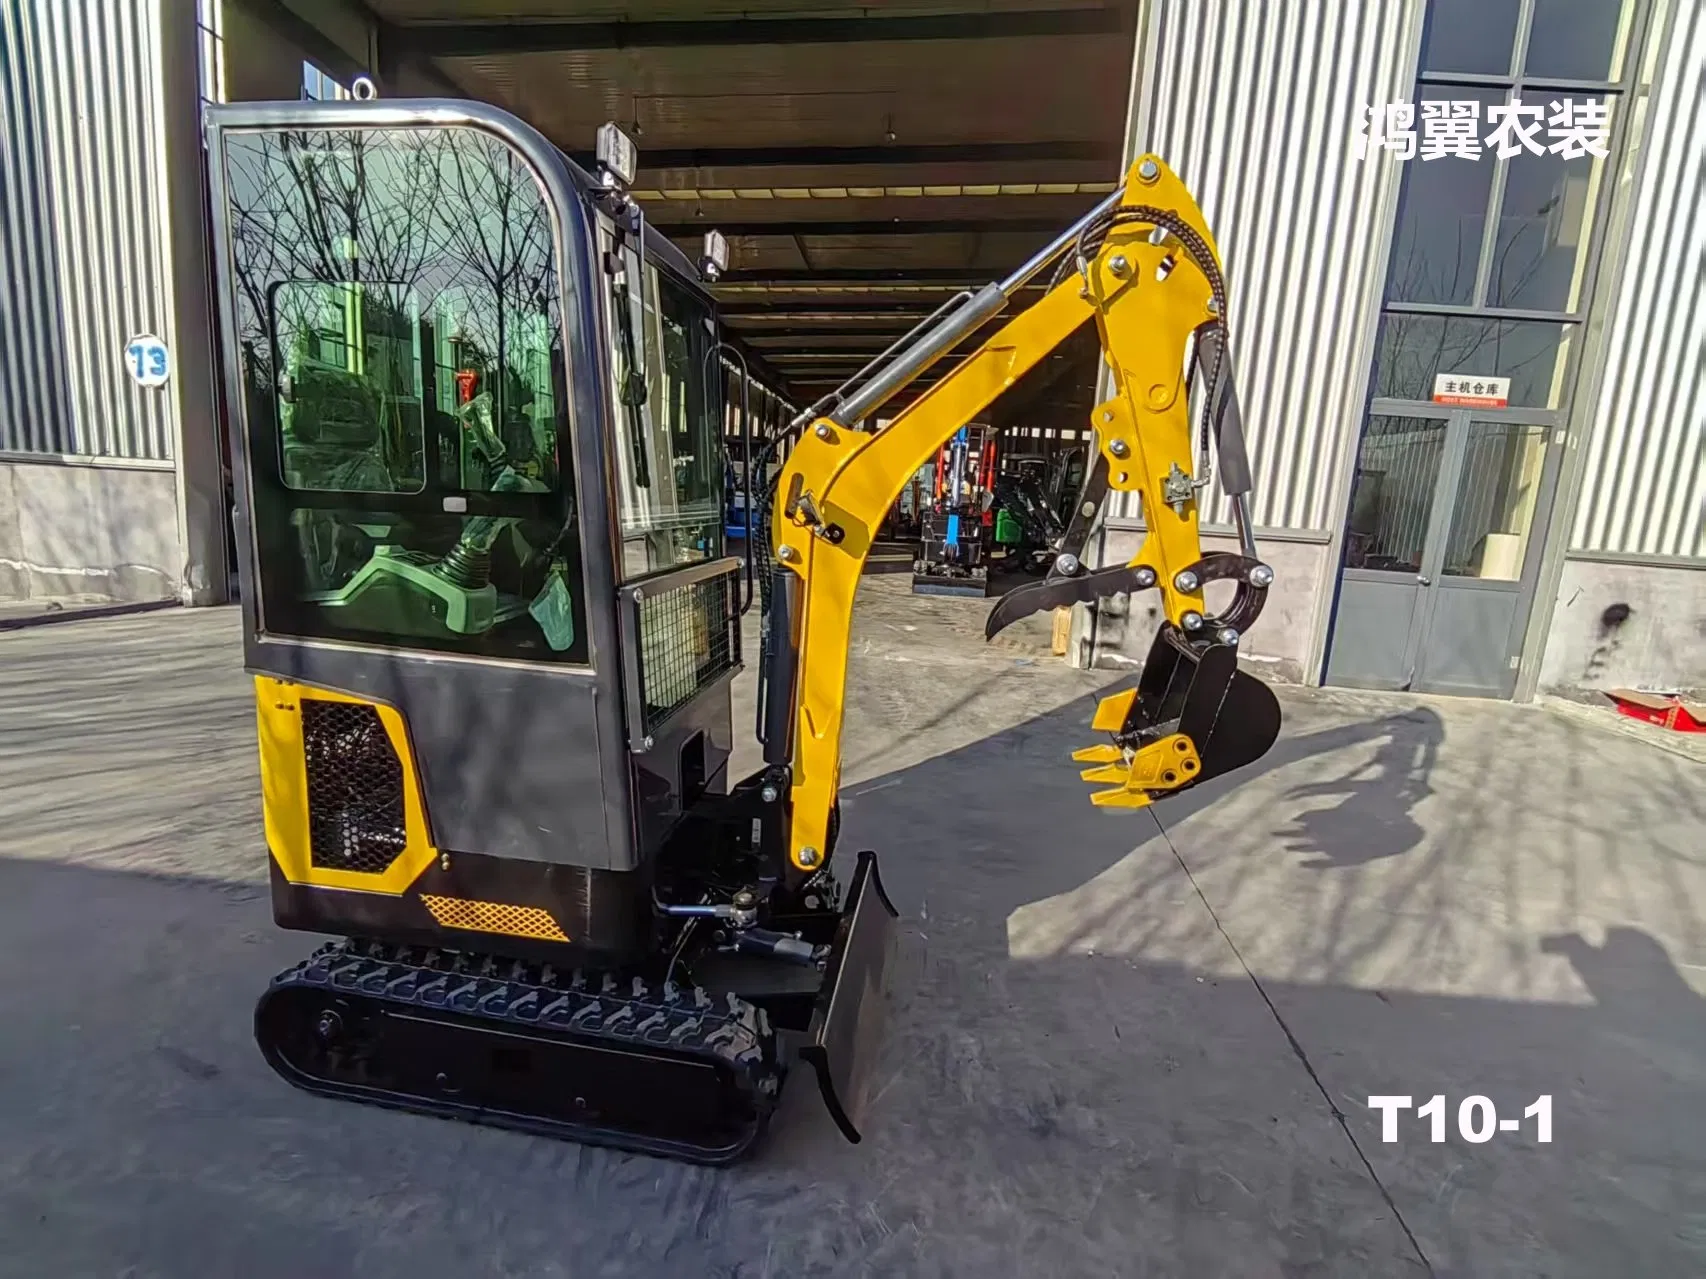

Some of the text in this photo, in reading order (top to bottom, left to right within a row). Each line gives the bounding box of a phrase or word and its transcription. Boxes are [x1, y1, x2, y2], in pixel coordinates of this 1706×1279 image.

[129, 345, 166, 378] 13
[1445, 381, 1499, 395] 主机仓库
